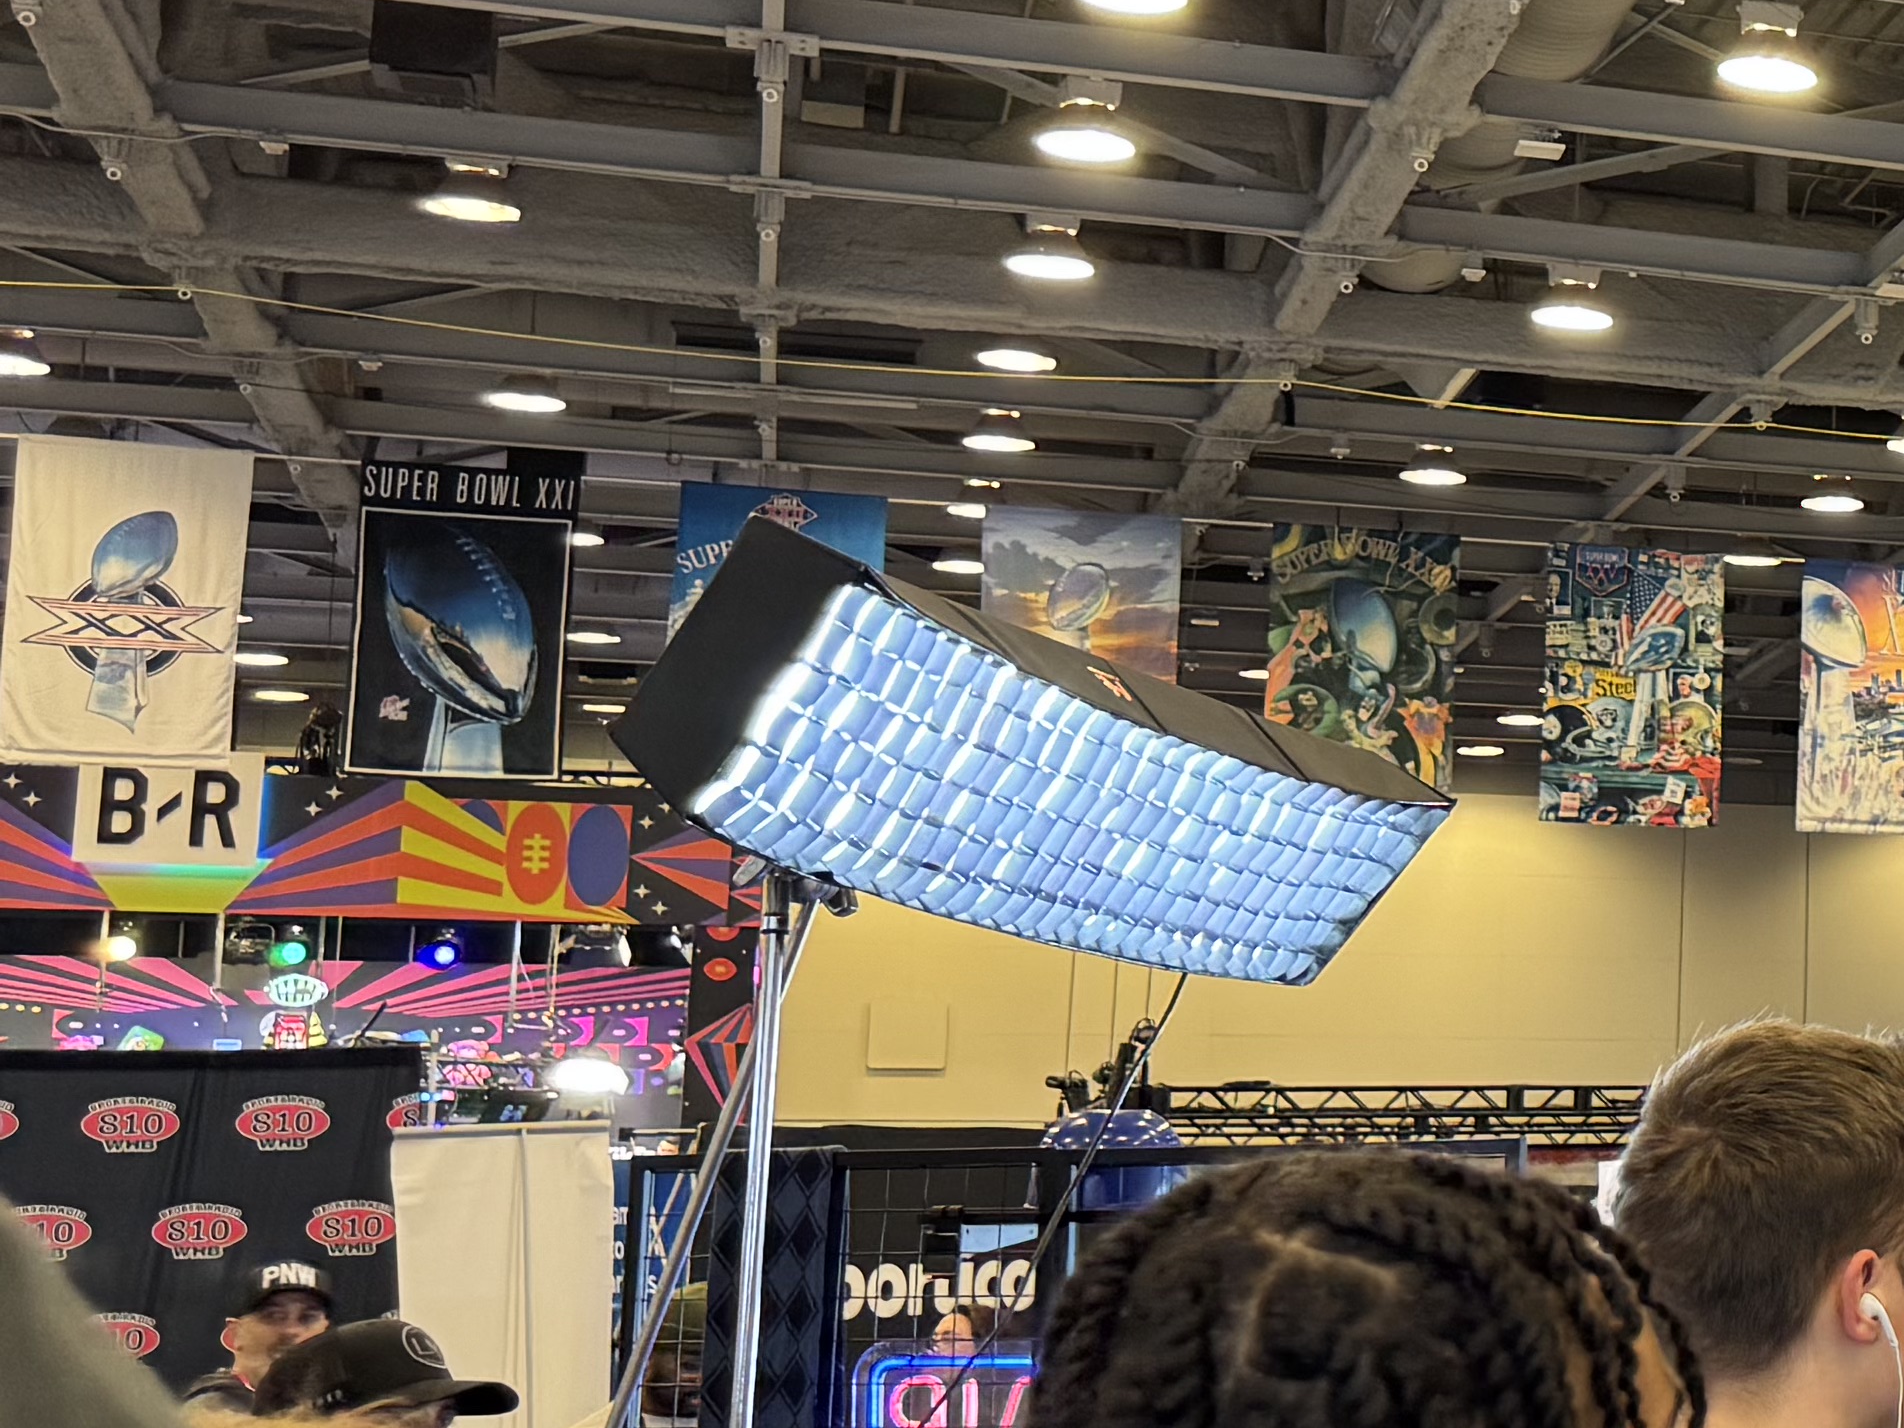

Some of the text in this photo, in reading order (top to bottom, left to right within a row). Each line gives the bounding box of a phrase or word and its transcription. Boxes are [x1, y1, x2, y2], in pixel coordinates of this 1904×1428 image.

[363, 465, 578, 511] SUPER BOWL XXI
[1272, 539, 1335, 584] SUPER
[67, 610, 185, 639] XX
[98, 1112, 166, 1135] 810
[251, 1111, 314, 1134] 810
[167, 1219, 231, 1243] 810
[322, 1215, 384, 1239] 810
